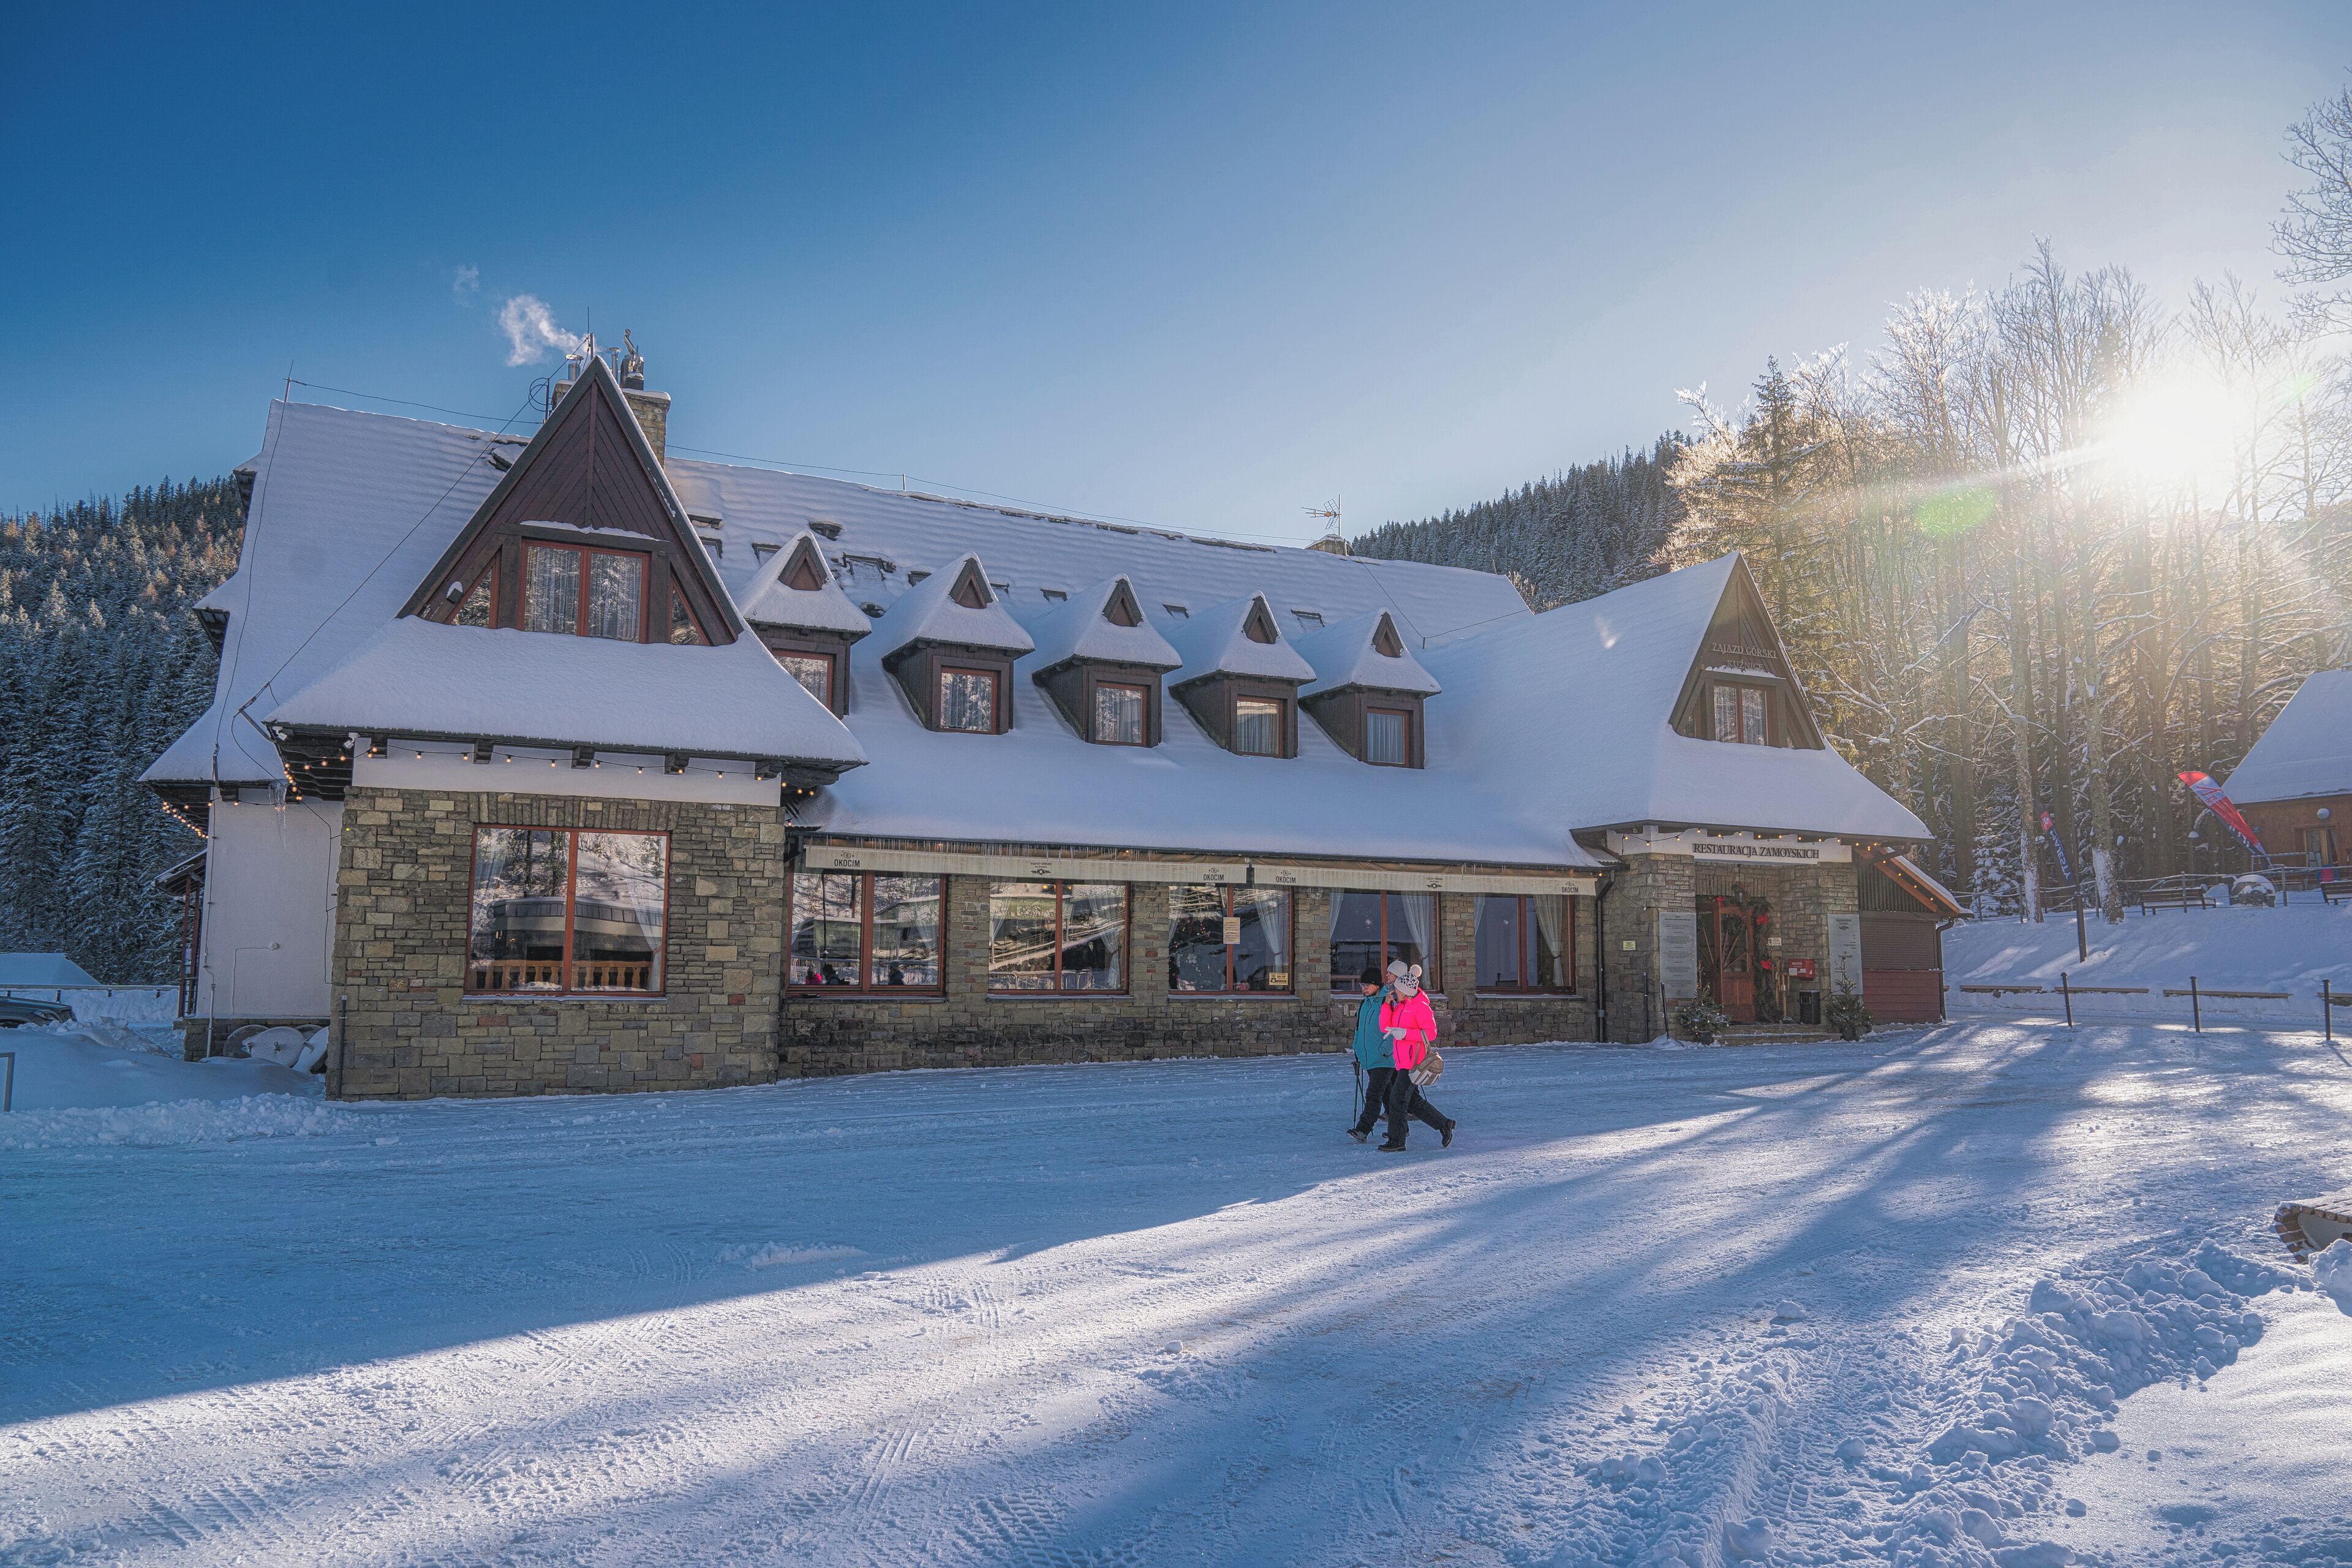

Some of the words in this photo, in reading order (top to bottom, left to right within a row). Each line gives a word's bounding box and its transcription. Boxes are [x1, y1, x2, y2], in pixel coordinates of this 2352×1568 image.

[1713, 643, 1743, 654] ZAJAZD
[1746, 646, 1776, 658] GÓRSKI
[1727, 659, 1763, 669] KUŹNICE
[1693, 843, 1758, 858] RESTAURACJA
[1760, 846, 1819, 859] ZAMOYSKICH
[834, 859, 860, 867] OKOCIM
